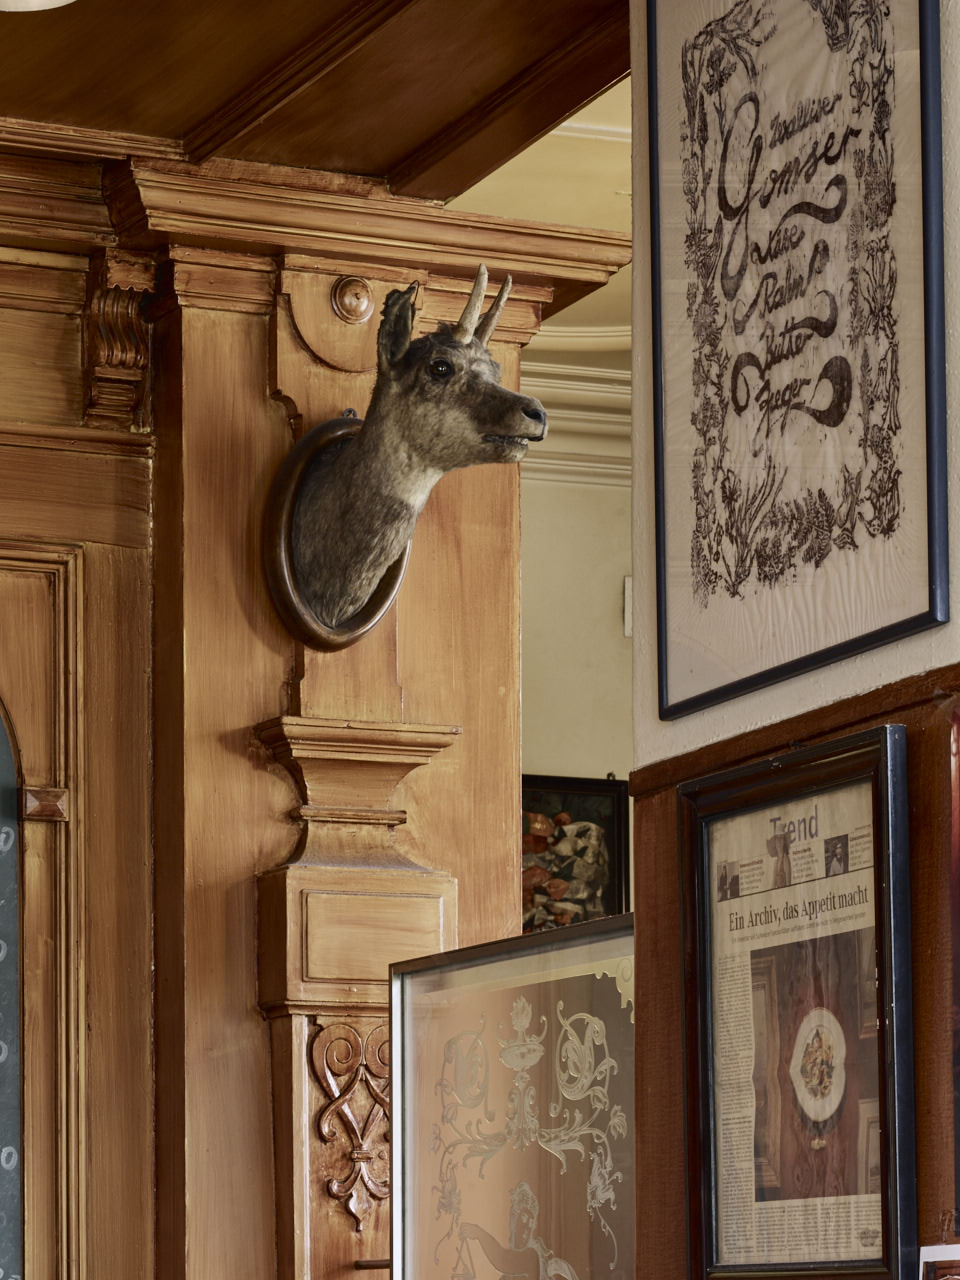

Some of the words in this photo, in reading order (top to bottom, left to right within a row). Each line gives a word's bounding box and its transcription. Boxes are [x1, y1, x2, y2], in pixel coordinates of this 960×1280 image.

[729, 911, 745, 932] Ein
[747, 903, 782, 927] Archiv,
[782, 901, 799, 920] das
[801, 891, 837, 921] Appetit
[838, 884, 869, 910] macht
